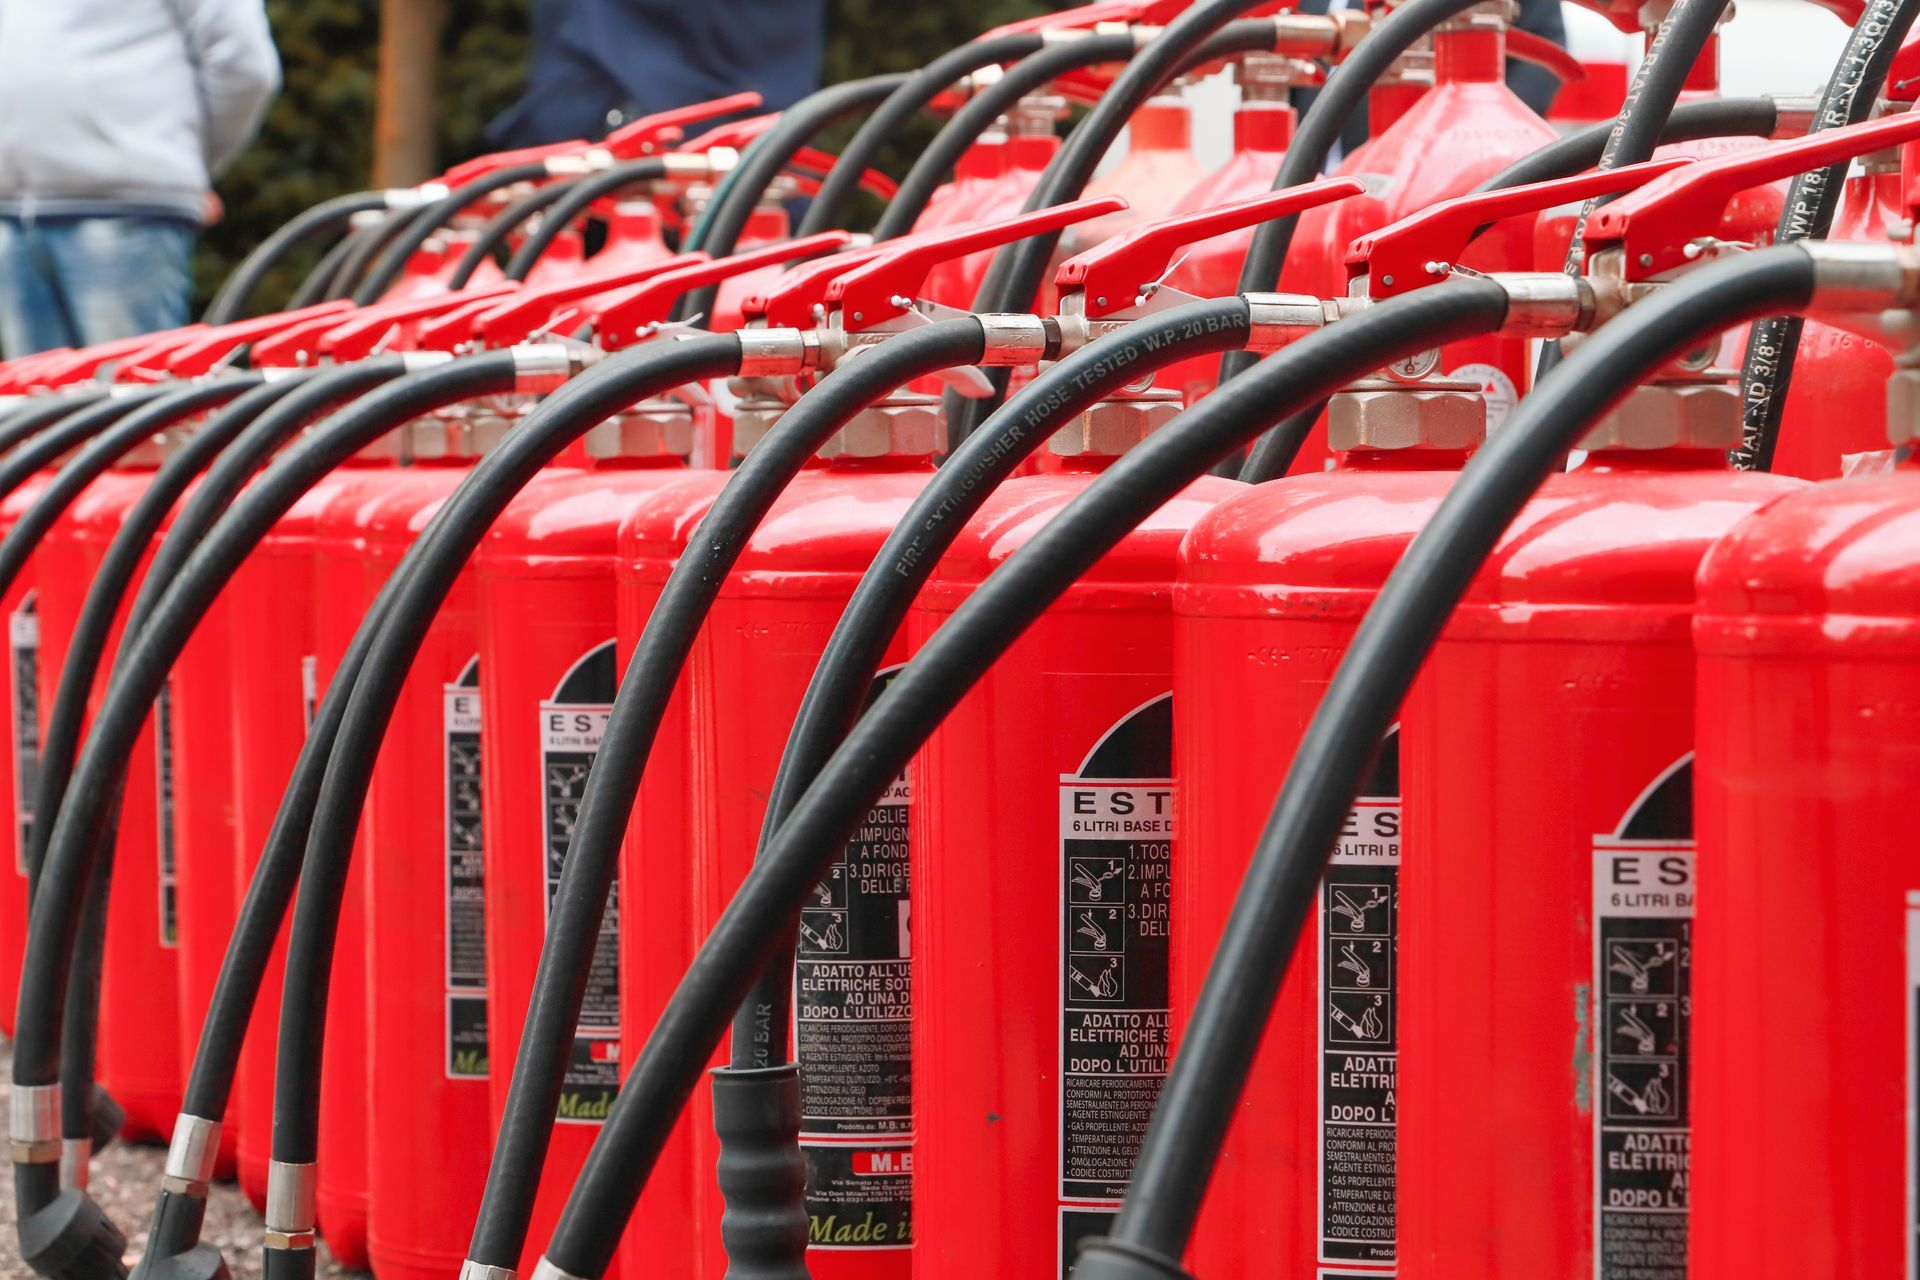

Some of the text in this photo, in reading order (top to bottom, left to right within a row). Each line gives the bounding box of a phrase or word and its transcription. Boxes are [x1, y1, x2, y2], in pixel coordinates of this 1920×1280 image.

[1788, 201, 1808, 236] WP
[1024, 385, 1072, 428] HOSE
[1071, 346, 1138, 390] TESTED
[1143, 329, 1181, 352] W.P.
[1184, 321, 1203, 340] 20
[1205, 312, 1246, 333] BAR
[863, 808, 907, 824] OGLIE
[1073, 820, 1161, 832] 6 LITRI BASE
[861, 845, 909, 860] A FOND
[1334, 843, 1341, 855] 6
[1345, 844, 1383, 856] LITRI
[1108, 860, 1114, 870] 1
[833, 869, 840, 879] 2
[1612, 857, 1689, 885] ES
[861, 880, 901, 894] DELLE
[1141, 883, 1149, 898] A
[1372, 888, 1378, 899] 1
[1611, 893, 1620, 906] 6
[1625, 893, 1669, 907] LITRI
[1109, 909, 1117, 920] 2
[1372, 941, 1381, 953] 2
[1110, 958, 1117, 968] 3
[812, 965, 865, 978] ADATTO
[802, 979, 880, 992] ELETTRICHE
[845, 993, 863, 1005] AD
[868, 992, 896, 1005] UNA
[1374, 995, 1382, 1006] 3
[803, 1006, 838, 1018] DOPO
[1656, 1003, 1668, 1018] 2
[754, 1003, 772, 1043] BAR
[1082, 1014, 1140, 1028] ADATTO
[833, 1034, 840, 1042] AL
[1070, 1029, 1158, 1043] ELETTRICHE
[1120, 1045, 1139, 1058] AD
[805, 1053, 829, 1062] AGENTE
[805, 1064, 880, 1073] GAS AZOTO
[1071, 1058, 1111, 1072] DOPO
[1659, 1063, 1669, 1078] 3
[1066, 1078, 1100, 1088] RICARICARE
[806, 1086, 866, 1095] ATTENZIONE AL GELO
[1066, 1089, 1152, 1099] CONFORMI AL PROTOTIPO
[806, 1096, 856, 1105] OMOLOGAZIONE
[1066, 1101, 1119, 1109] SEMESTRALMENTE
[1120, 1101, 1130, 1109] DA
[806, 1106, 828, 1115] CODICE
[1072, 1110, 1098, 1119] AGENTE
[1331, 1105, 1376, 1121] DOPO
[837, 1122, 865, 1130] Prodotto
[879, 1121, 898, 1130] M.B.
[1071, 1122, 1084, 1131] GAS
[1327, 1127, 1364, 1138] RICARICARE
[1072, 1134, 1117, 1143] TEMPERATURE
[1118, 1135, 1125, 1143] DI
[1071, 1146, 1139, 1155] ATTENZIONE AL GELO
[1327, 1140, 1366, 1150] CONFORMI
[1367, 1141, 1377, 1151] AL
[1071, 1157, 1128, 1167] OMOLOGAZIONE
[1327, 1152, 1396, 1163] SEMESTRALMENTE DA
[1070, 1168, 1096, 1177] CODICE
[1333, 1163, 1362, 1173] AGENTE
[1332, 1175, 1347, 1186] GAS
[1332, 1189, 1391, 1201] TEMPERATURE DI
[1609, 1188, 1662, 1207] DOPO
[1332, 1202, 1387, 1213] ATTENZIONE AL
[1332, 1214, 1395, 1226] OMOLOGAZIONE
[809, 1212, 888, 1243] Made
[1331, 1227, 1359, 1238] CODICE
